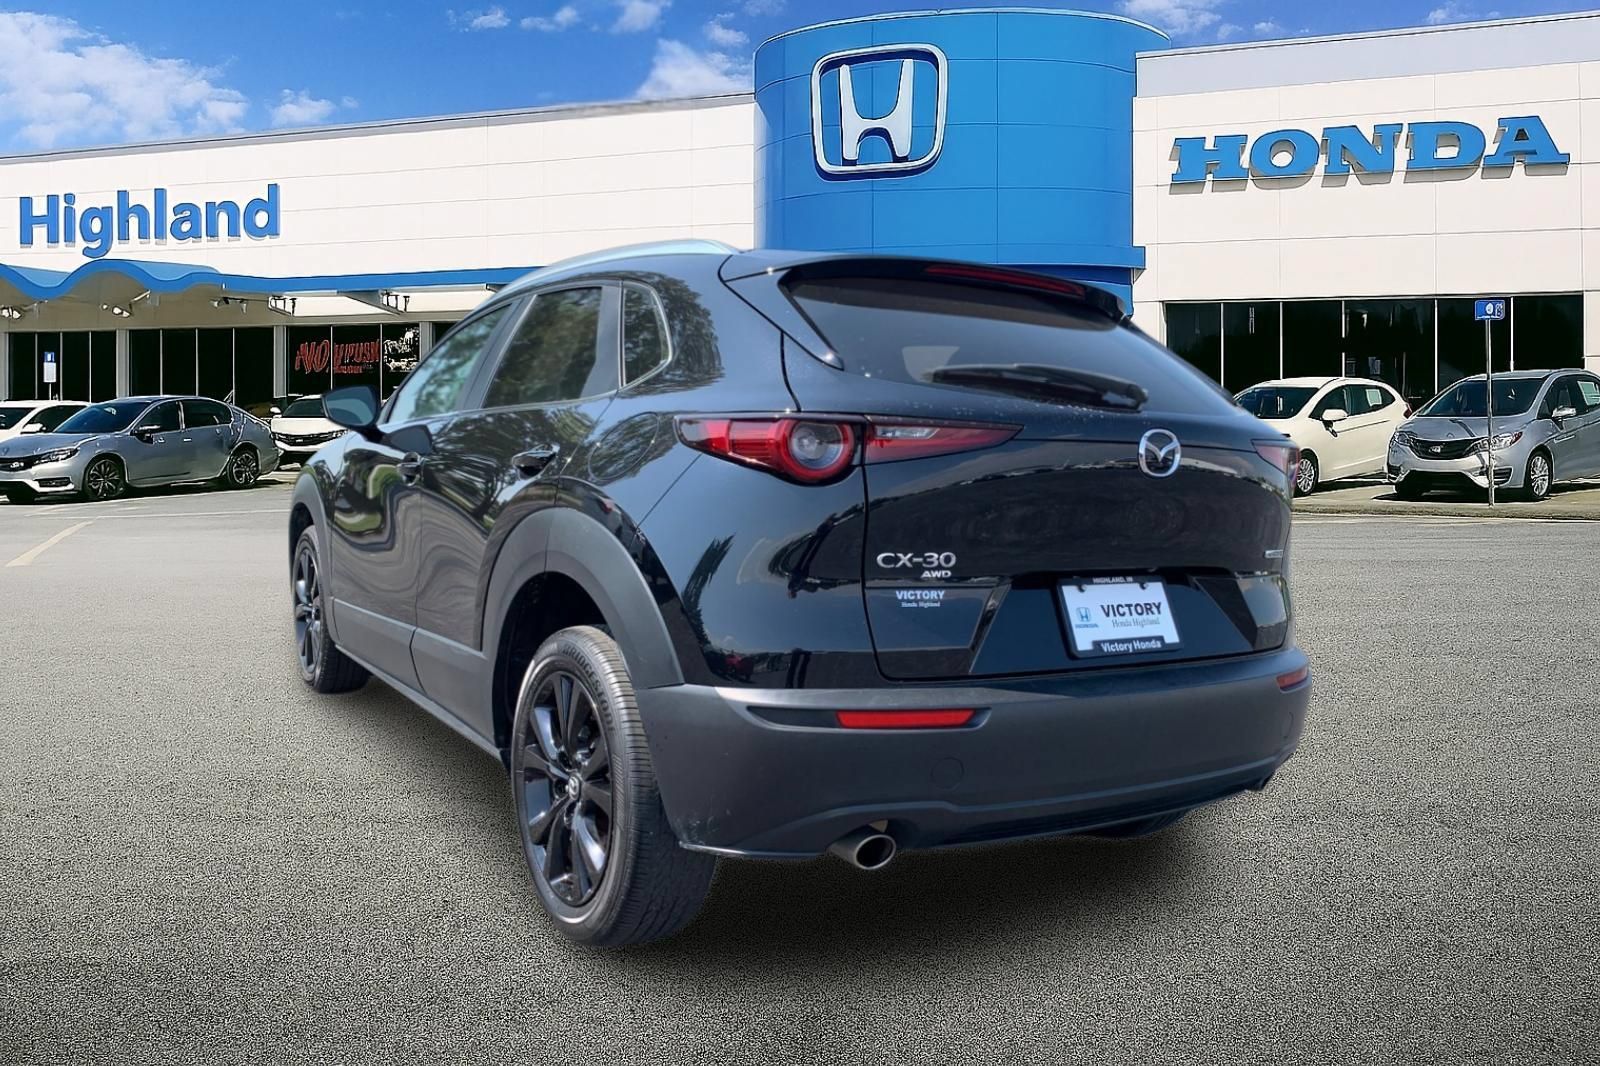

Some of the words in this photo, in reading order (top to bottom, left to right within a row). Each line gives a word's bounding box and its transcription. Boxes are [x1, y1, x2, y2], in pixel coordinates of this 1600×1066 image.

[1171, 115, 1571, 183] HONDA
[19, 183, 281, 258] Highland
[876, 552, 957, 568] CX-30
[920, 570, 952, 578] AWD
[895, 590, 945, 600] VICTORY
[1100, 602, 1162, 617] VICTORY
[1112, 619, 1132, 629] Honda
[1133, 618, 1160, 628] Highland
[1100, 643, 1133, 653] Victory
[1133, 640, 1162, 651] Honda
